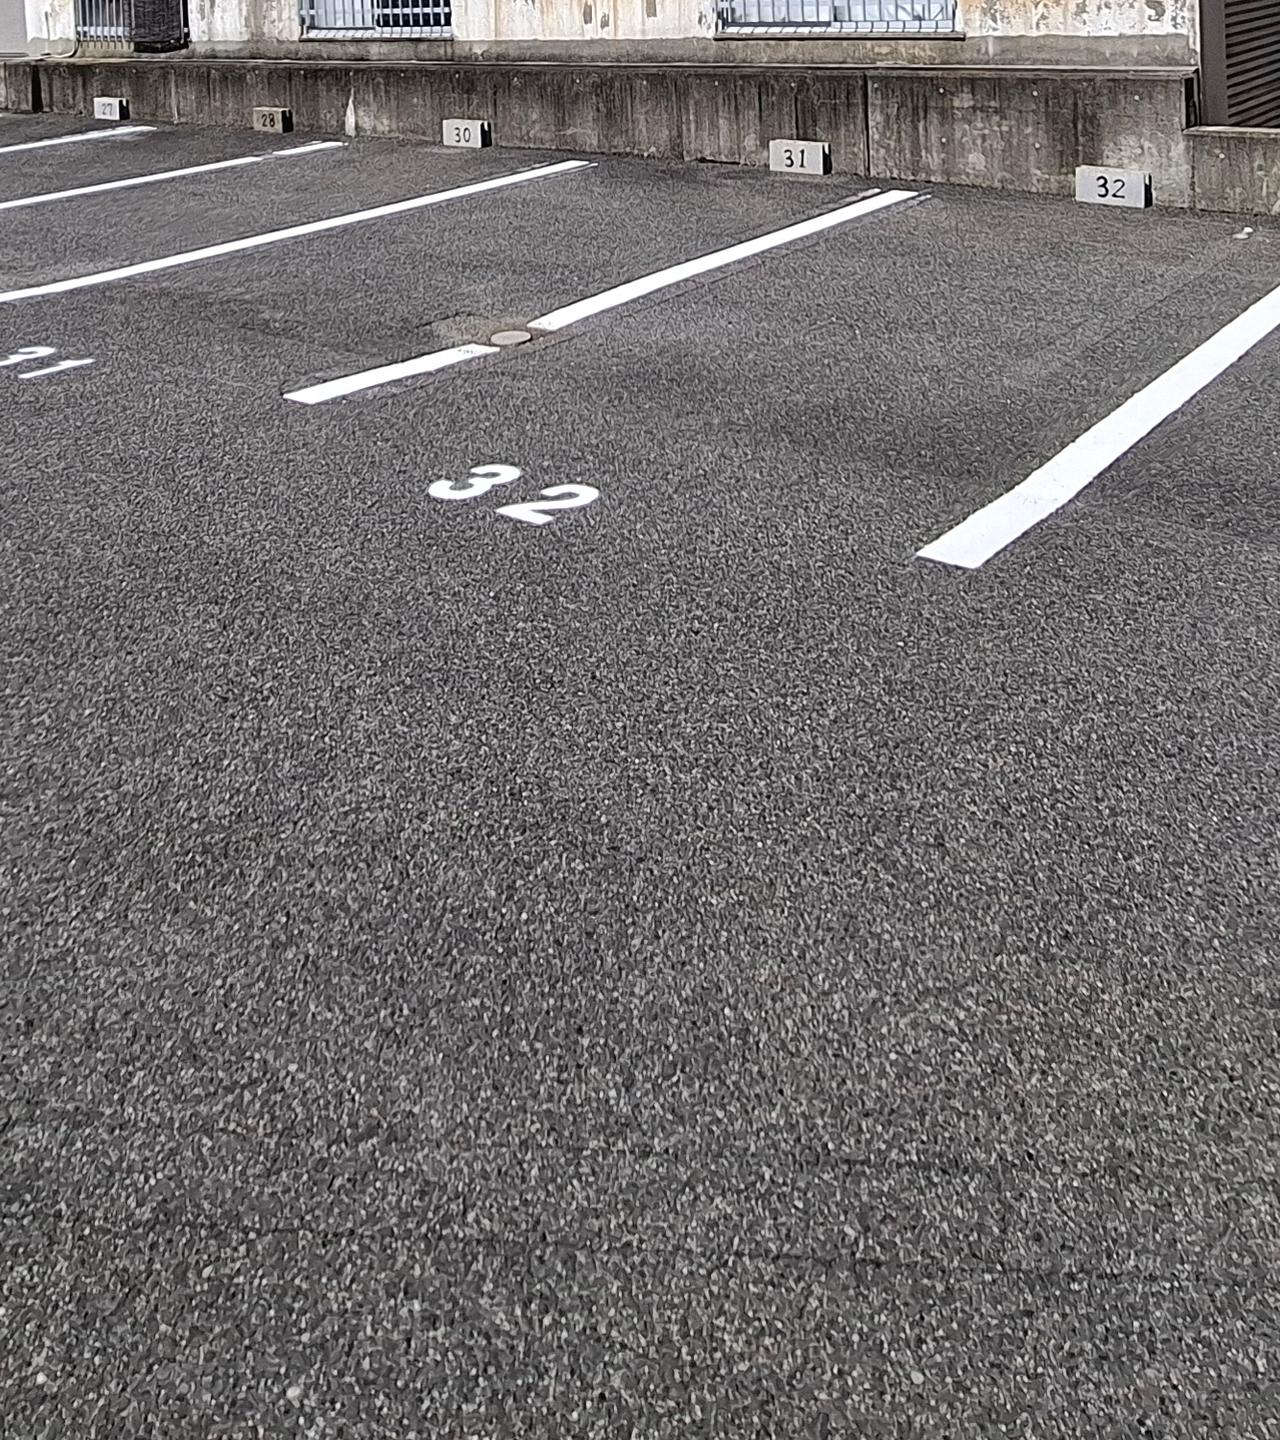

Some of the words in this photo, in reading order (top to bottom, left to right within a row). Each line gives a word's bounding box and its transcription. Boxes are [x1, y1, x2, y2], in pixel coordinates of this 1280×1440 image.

[101, 103, 113, 116] 27
[261, 113, 276, 128] 28
[454, 127, 471, 143] 30
[784, 149, 806, 168] 31
[1096, 175, 1126, 199] 32
[427, 464, 600, 525] 32
